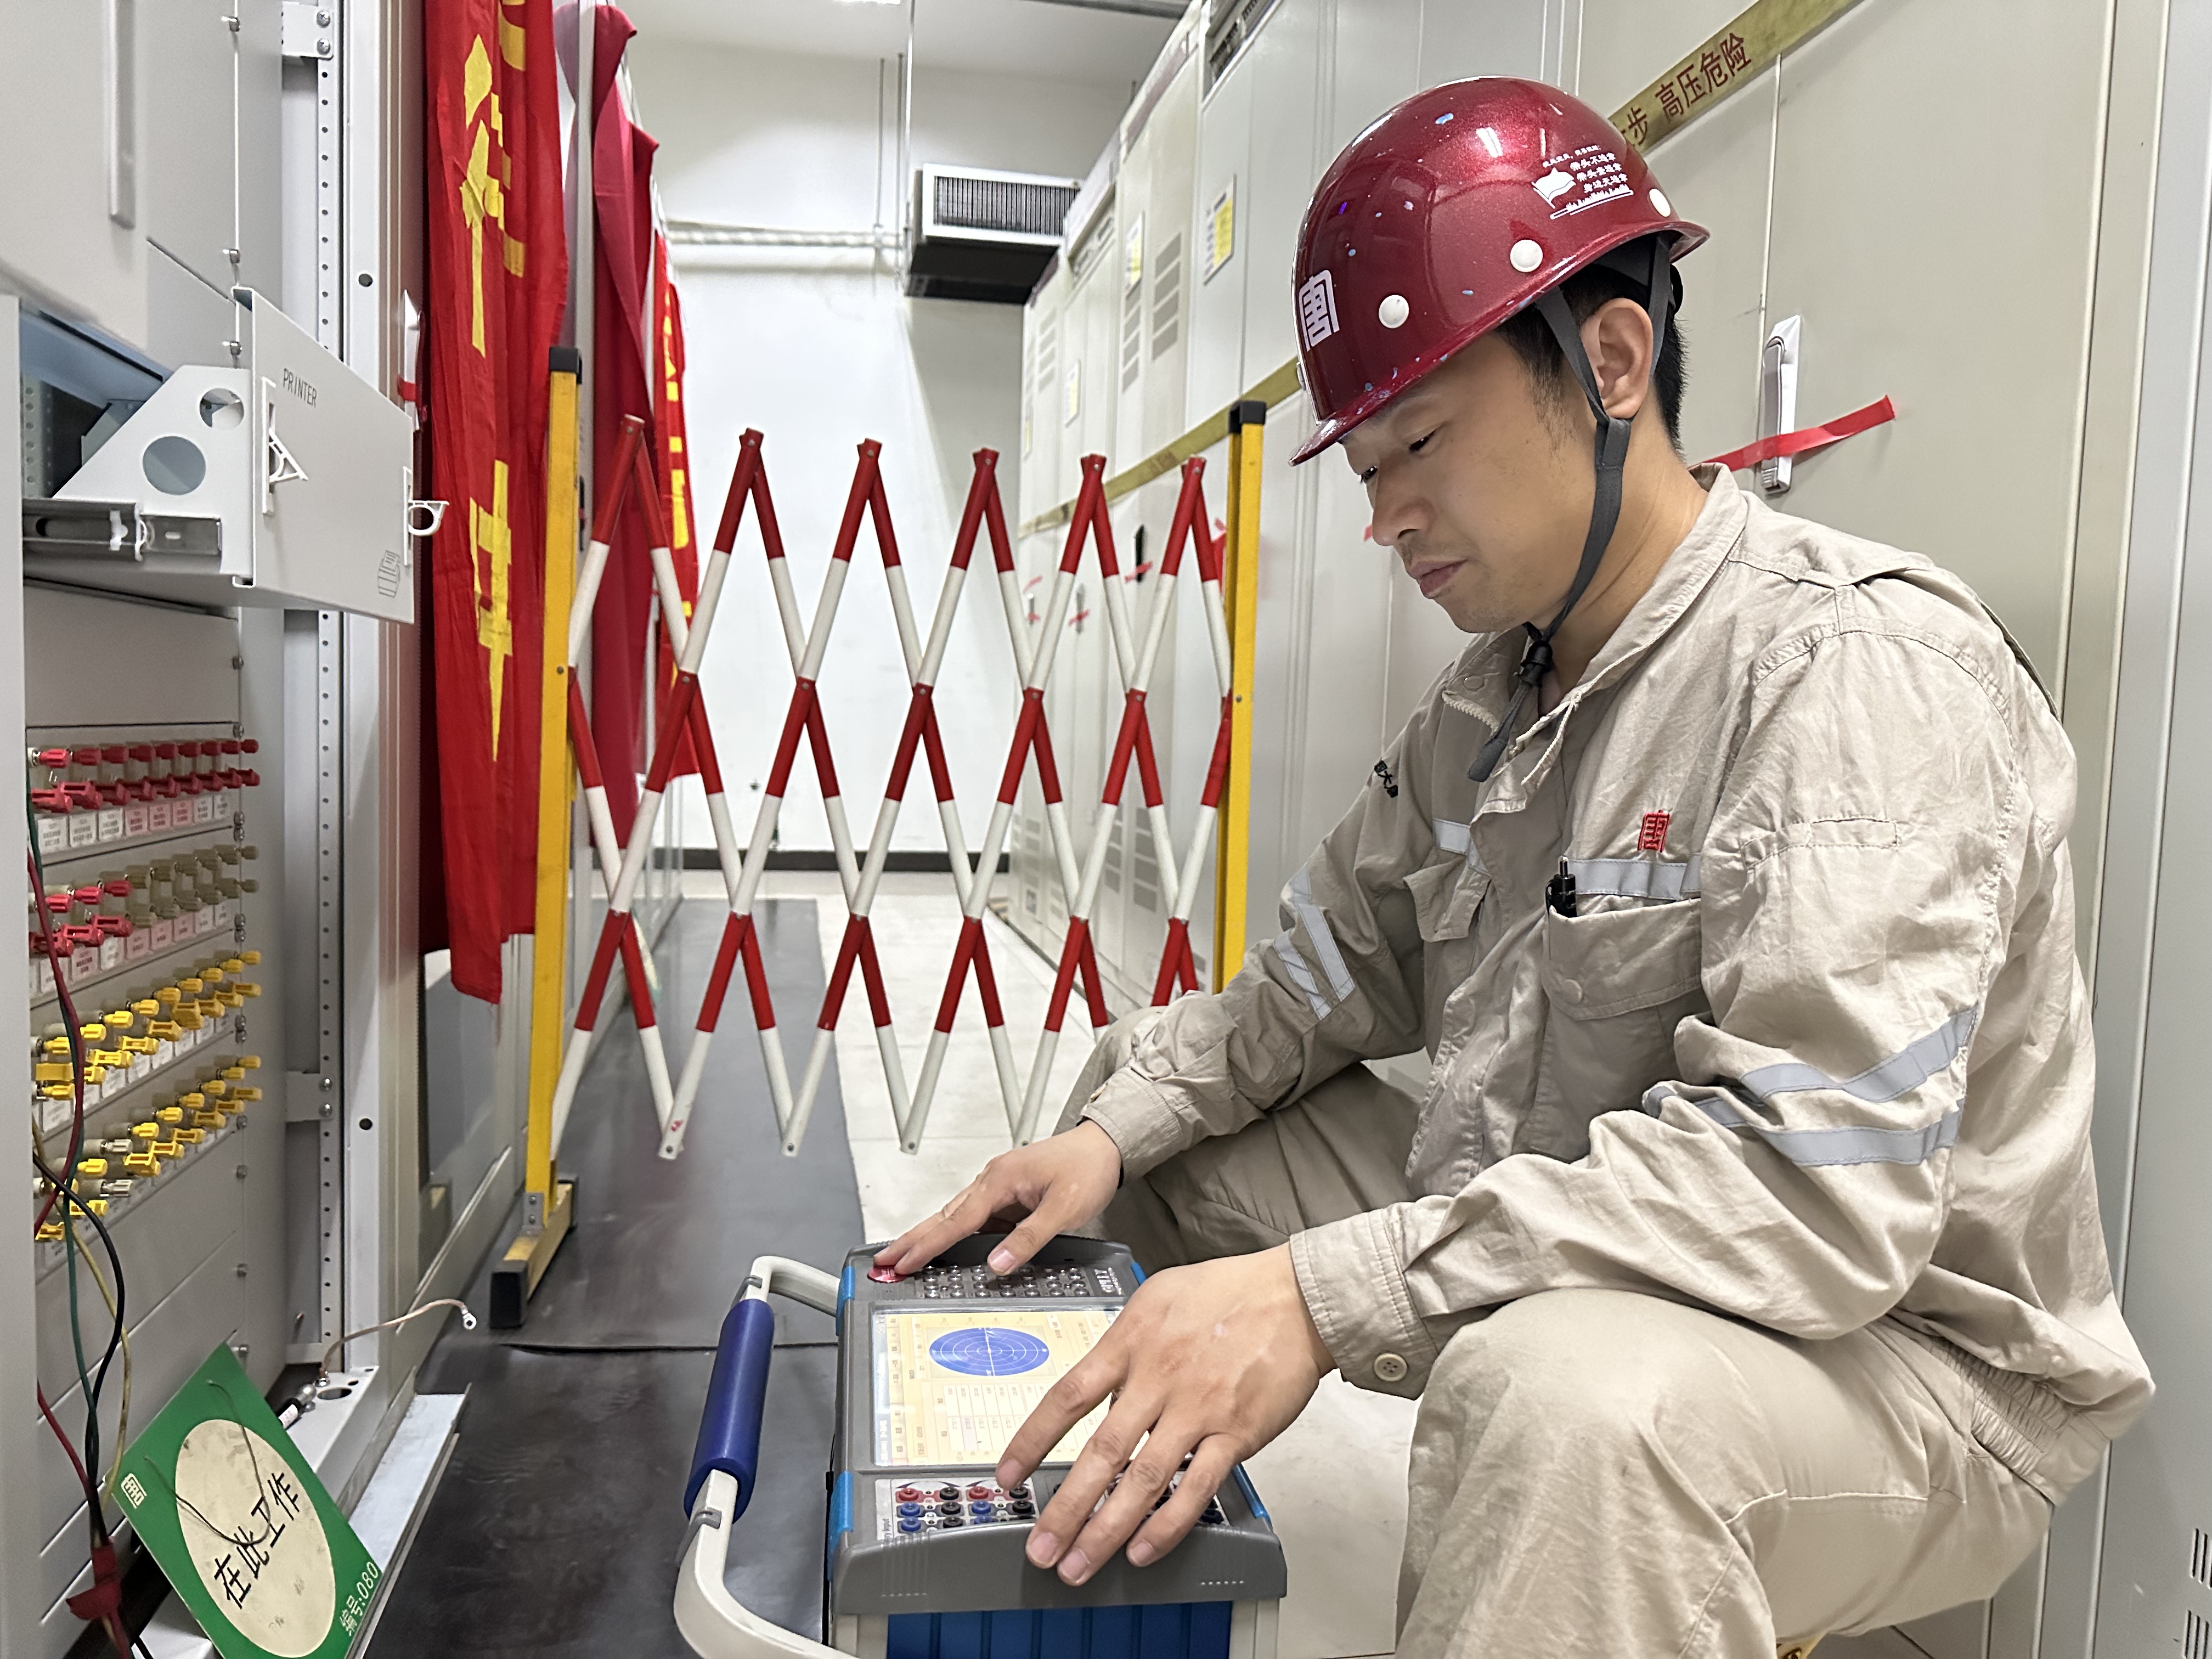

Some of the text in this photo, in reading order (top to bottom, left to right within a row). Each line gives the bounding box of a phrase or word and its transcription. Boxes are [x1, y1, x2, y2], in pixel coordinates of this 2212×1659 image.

[1613, 32, 1752, 146] 步 高压危险
[283, 368, 317, 408] PRINTER
[213, 1472, 300, 1610] 在此工作
